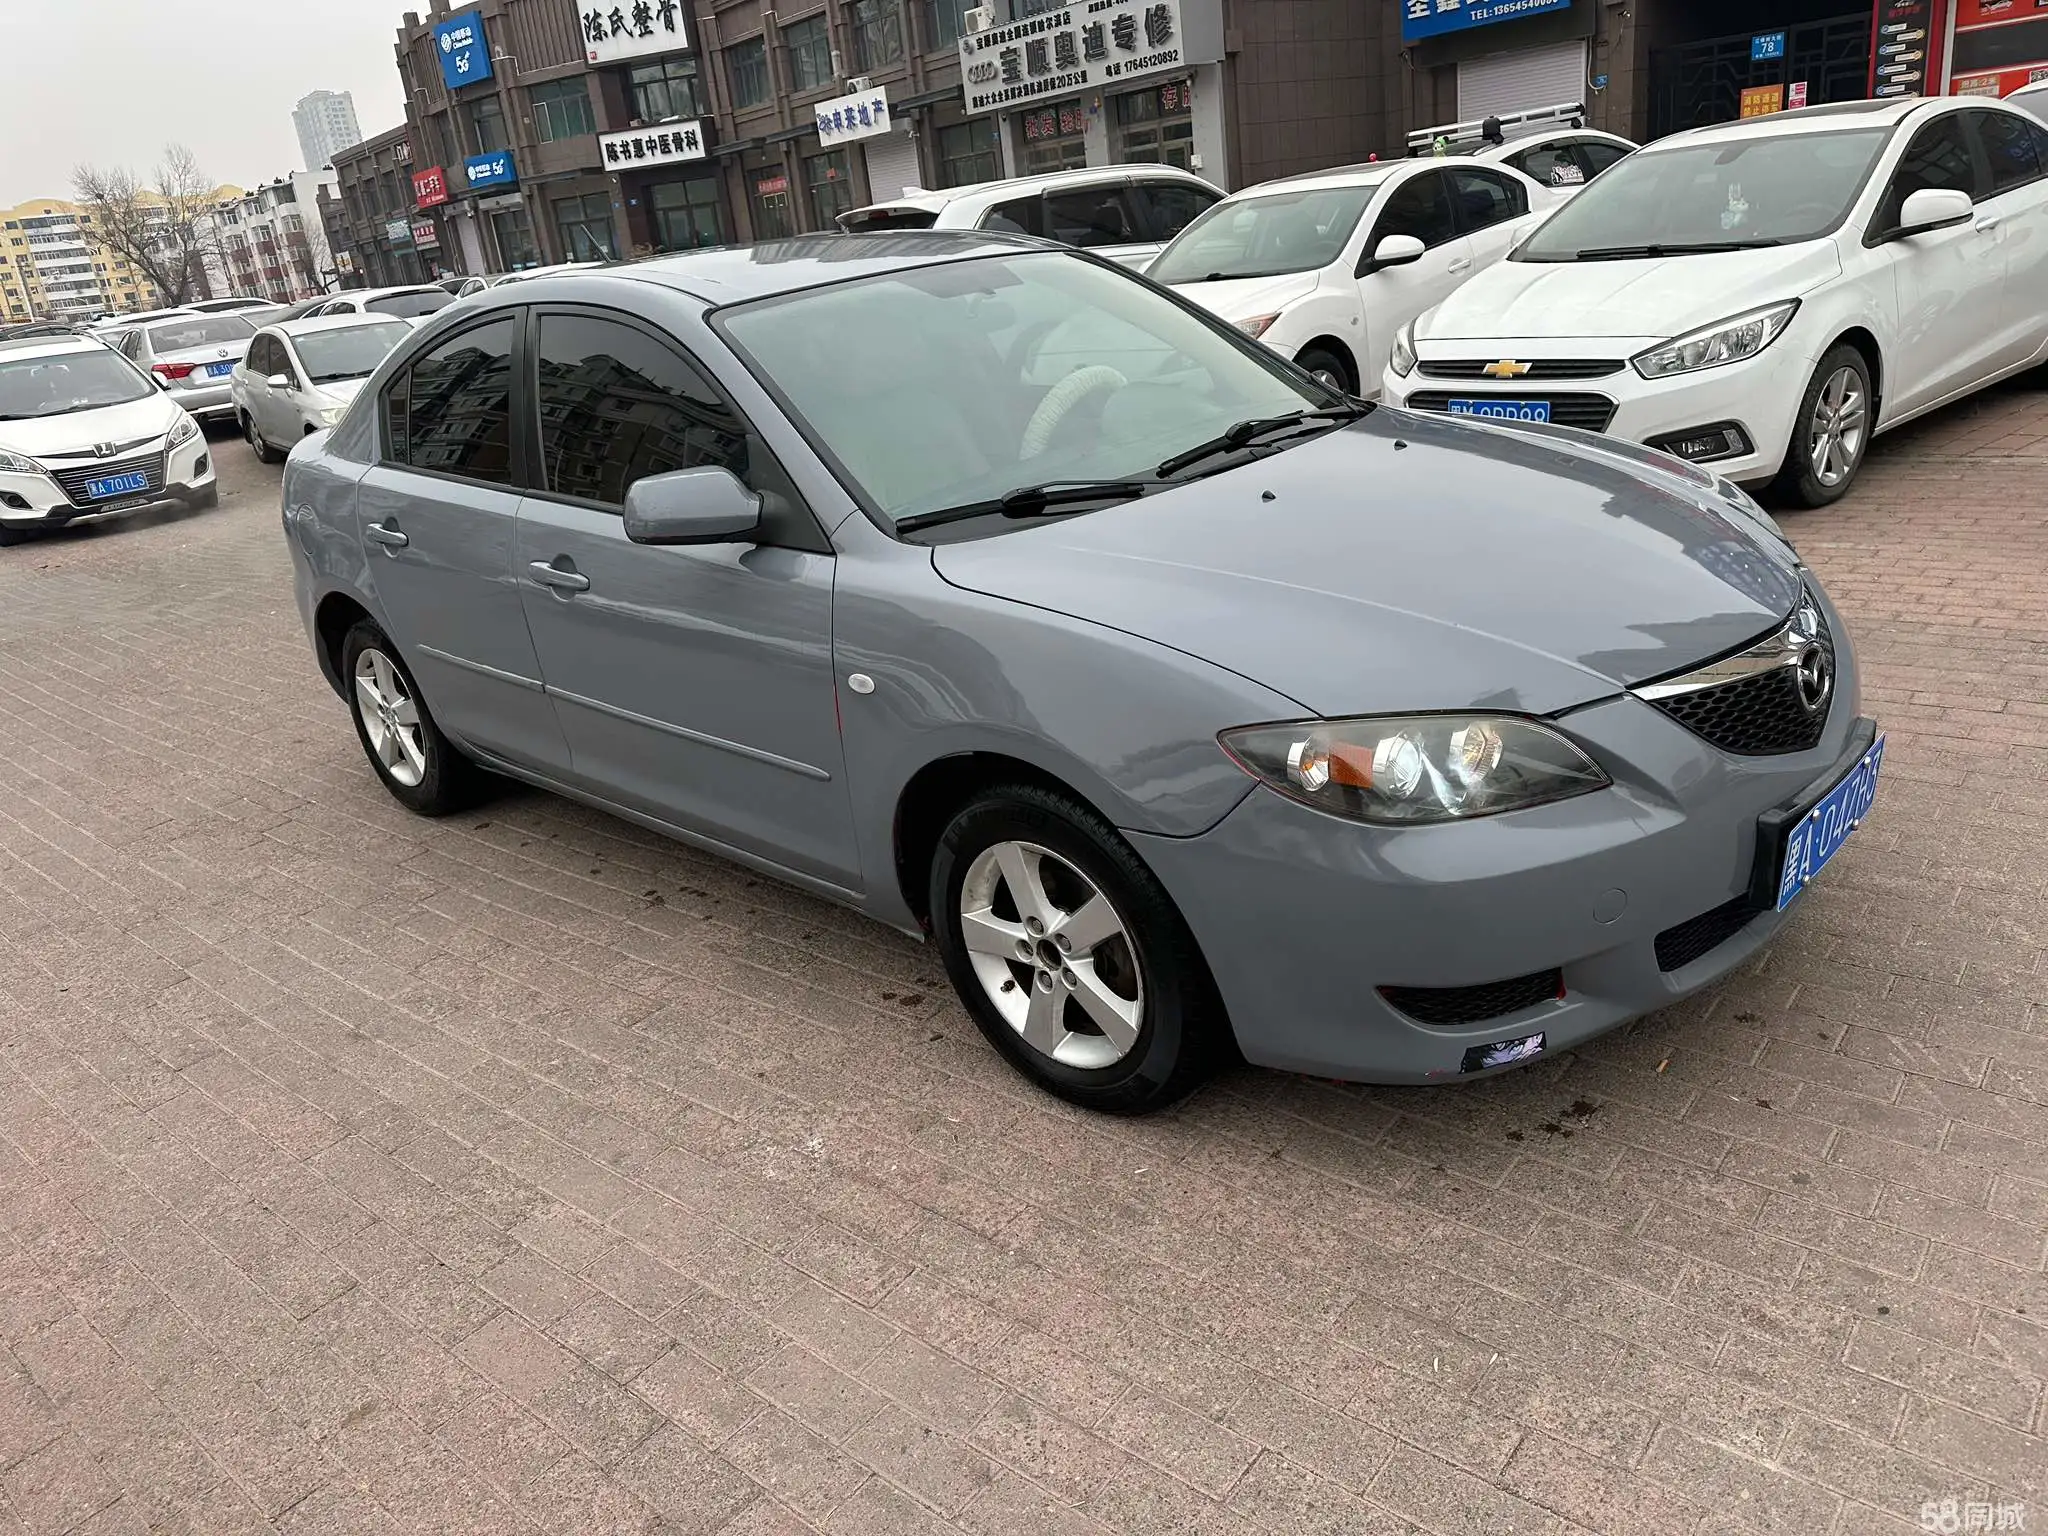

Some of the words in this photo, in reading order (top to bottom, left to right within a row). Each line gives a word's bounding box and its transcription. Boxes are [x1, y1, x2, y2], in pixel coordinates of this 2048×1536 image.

[583, 0, 677, 43] 陈氏整骨
[1000, 3, 1173, 85] 宝顺奥迪专修
[1761, 42, 1774, 53] 78
[456, 54, 469, 73] 5G
[1124, 49, 1179, 72] 17645120892
[1743, 92, 1779, 106] 消防通道
[605, 129, 698, 162] 陈书惠中医骨科
